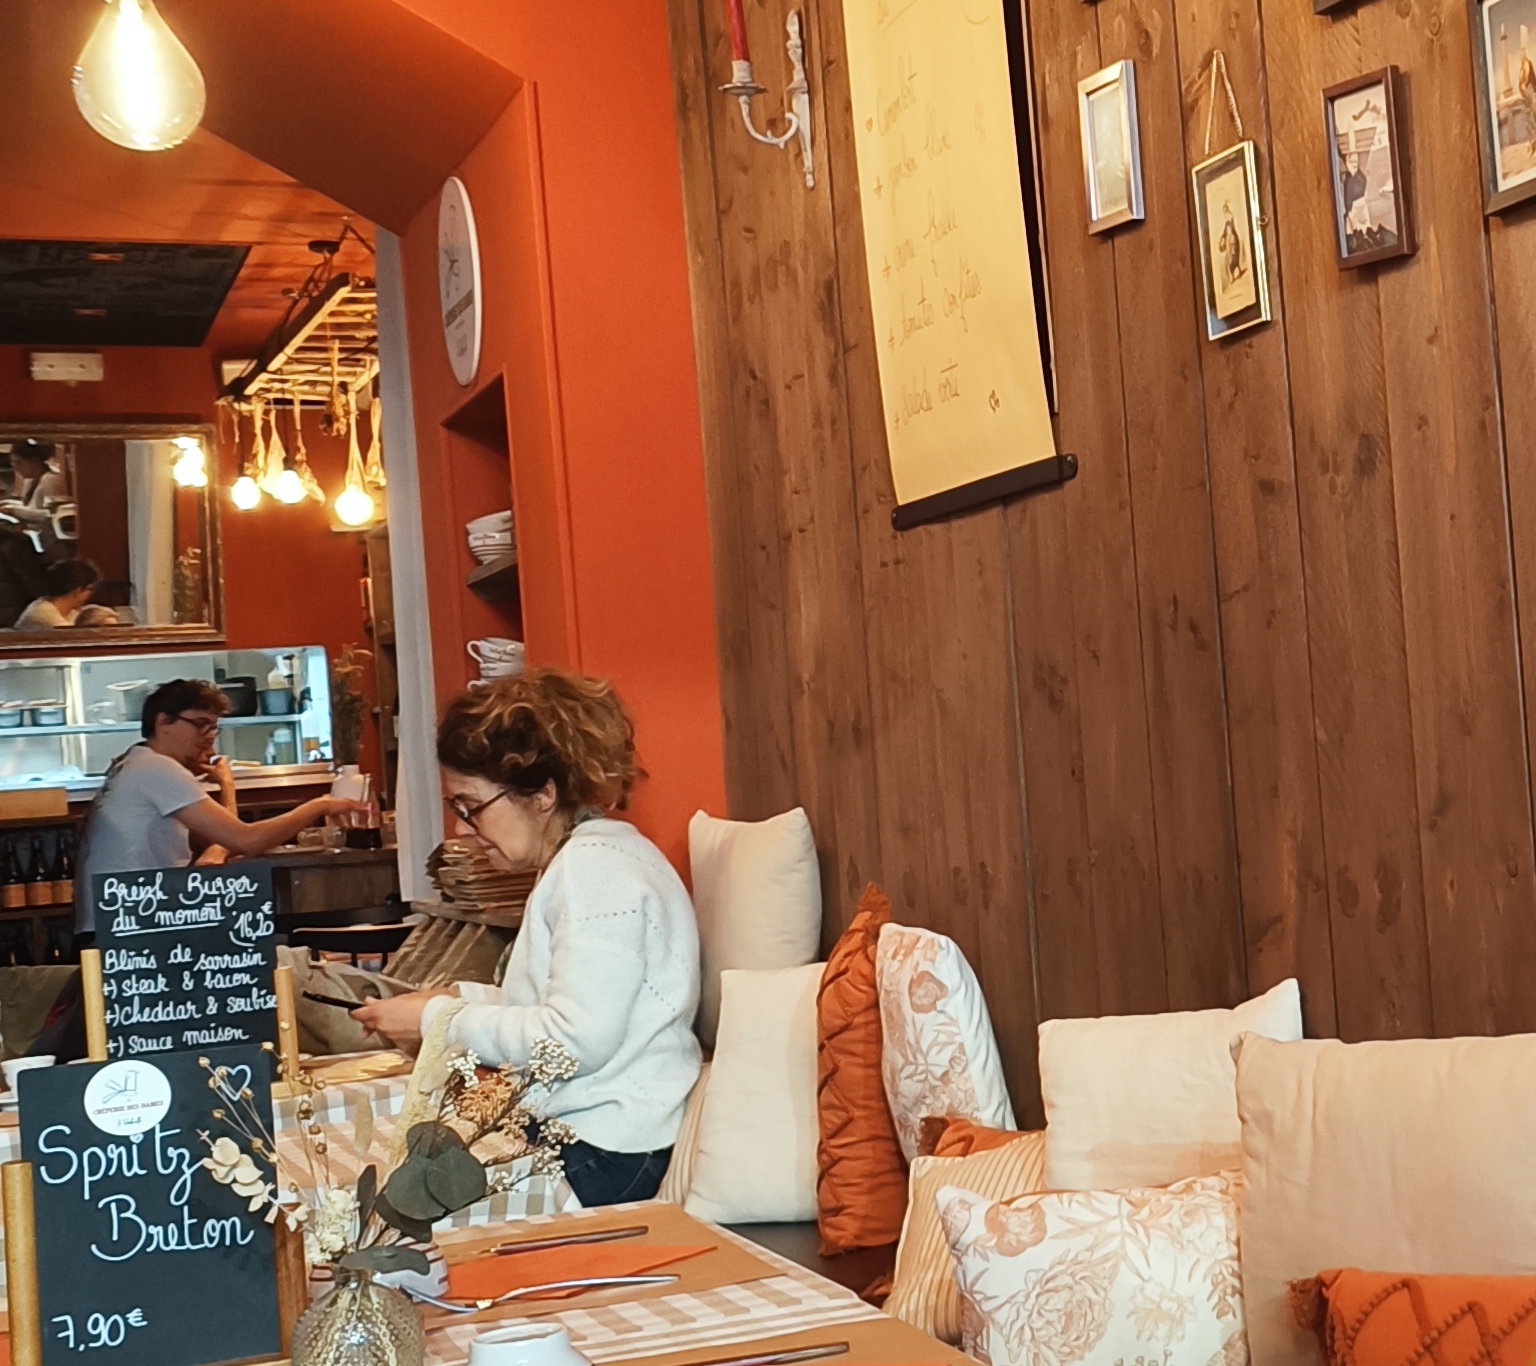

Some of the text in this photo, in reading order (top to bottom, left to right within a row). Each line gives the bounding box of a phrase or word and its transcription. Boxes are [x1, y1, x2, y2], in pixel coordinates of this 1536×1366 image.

[98, 871, 259, 916] Breizh Burger
[111, 897, 226, 933] du moment
[103, 943, 268, 974] Blinis de sarrasin
[182, 970, 194, 991] &
[203, 971, 259, 989] bacon
[206, 996, 218, 1015] &
[182, 1023, 250, 1046] maison
[38, 1122, 205, 1206] Spritz
[90, 1194, 256, 1262] Breton
[50, 1307, 149, 1353] 7,90€
